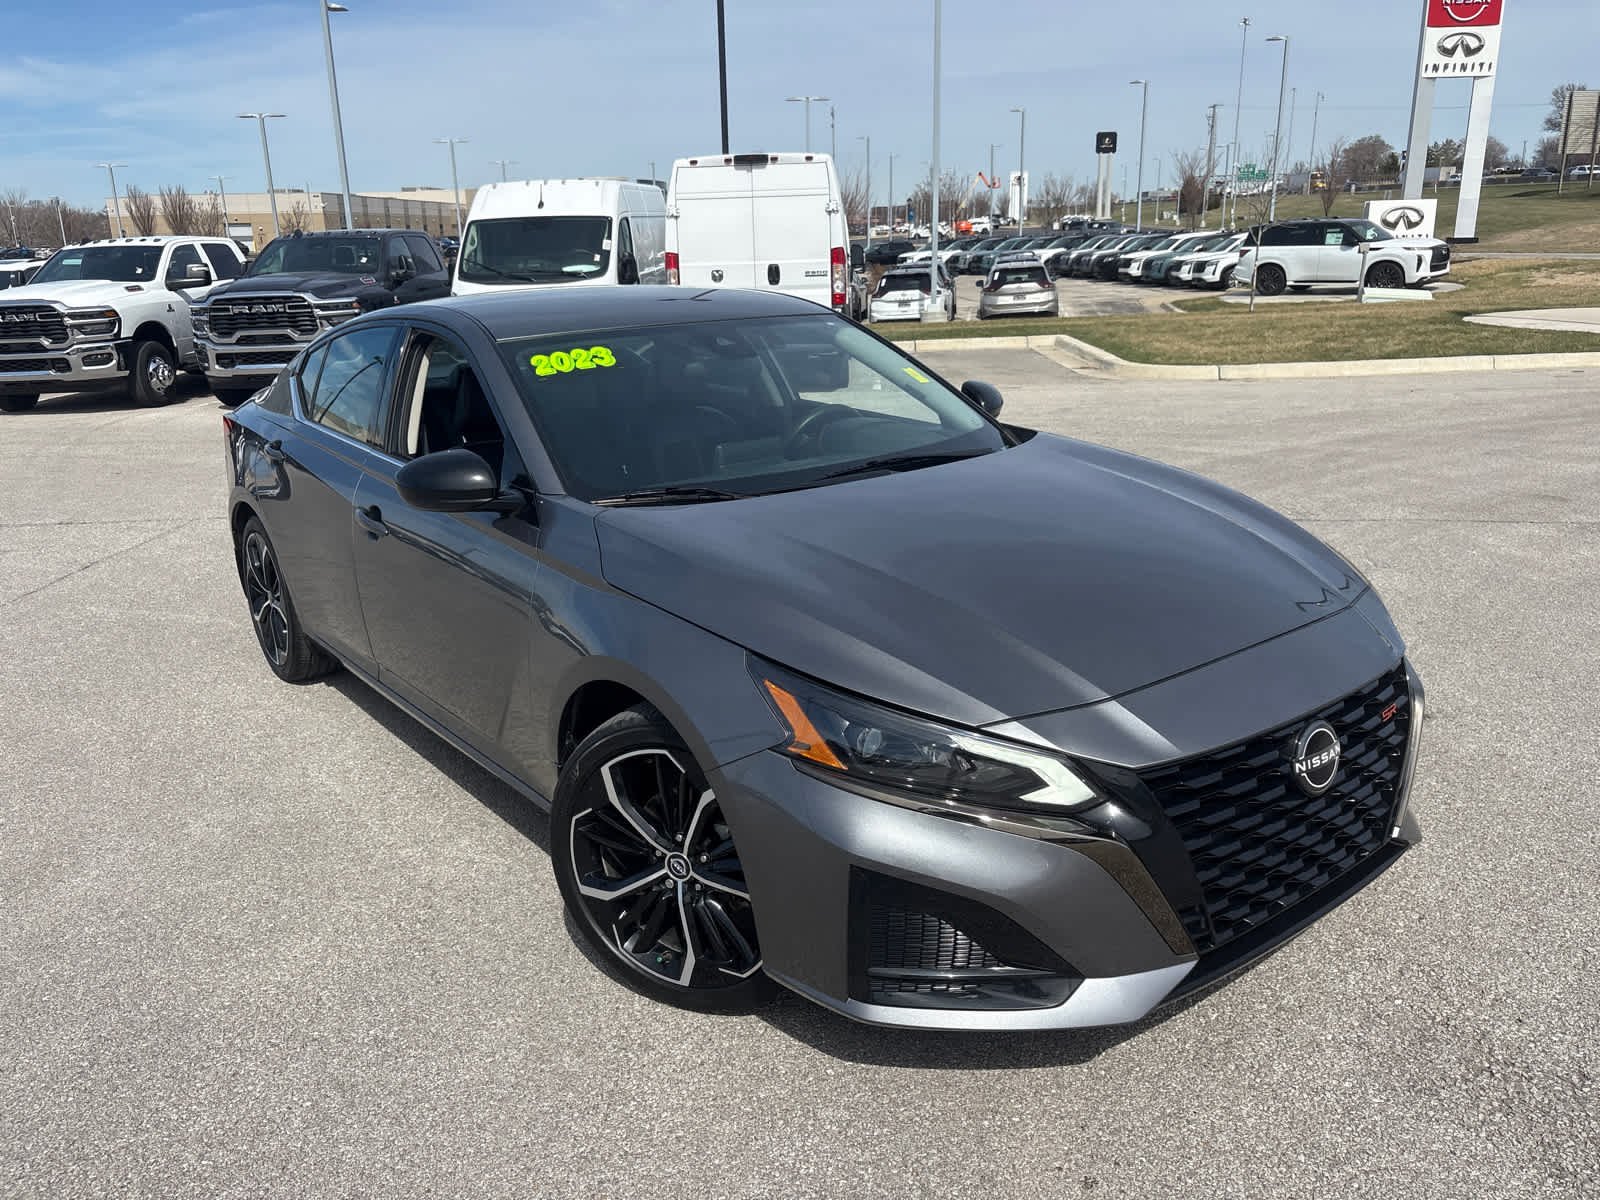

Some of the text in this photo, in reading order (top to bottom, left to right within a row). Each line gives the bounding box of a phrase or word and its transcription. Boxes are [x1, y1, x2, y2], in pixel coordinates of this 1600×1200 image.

[1424, 61, 1493, 73] INFINITI
[232, 303, 286, 314] RAM
[530, 346, 617, 376] 2023
[1382, 703, 1398, 721] SR
[1295, 744, 1341, 773] NISSAN
